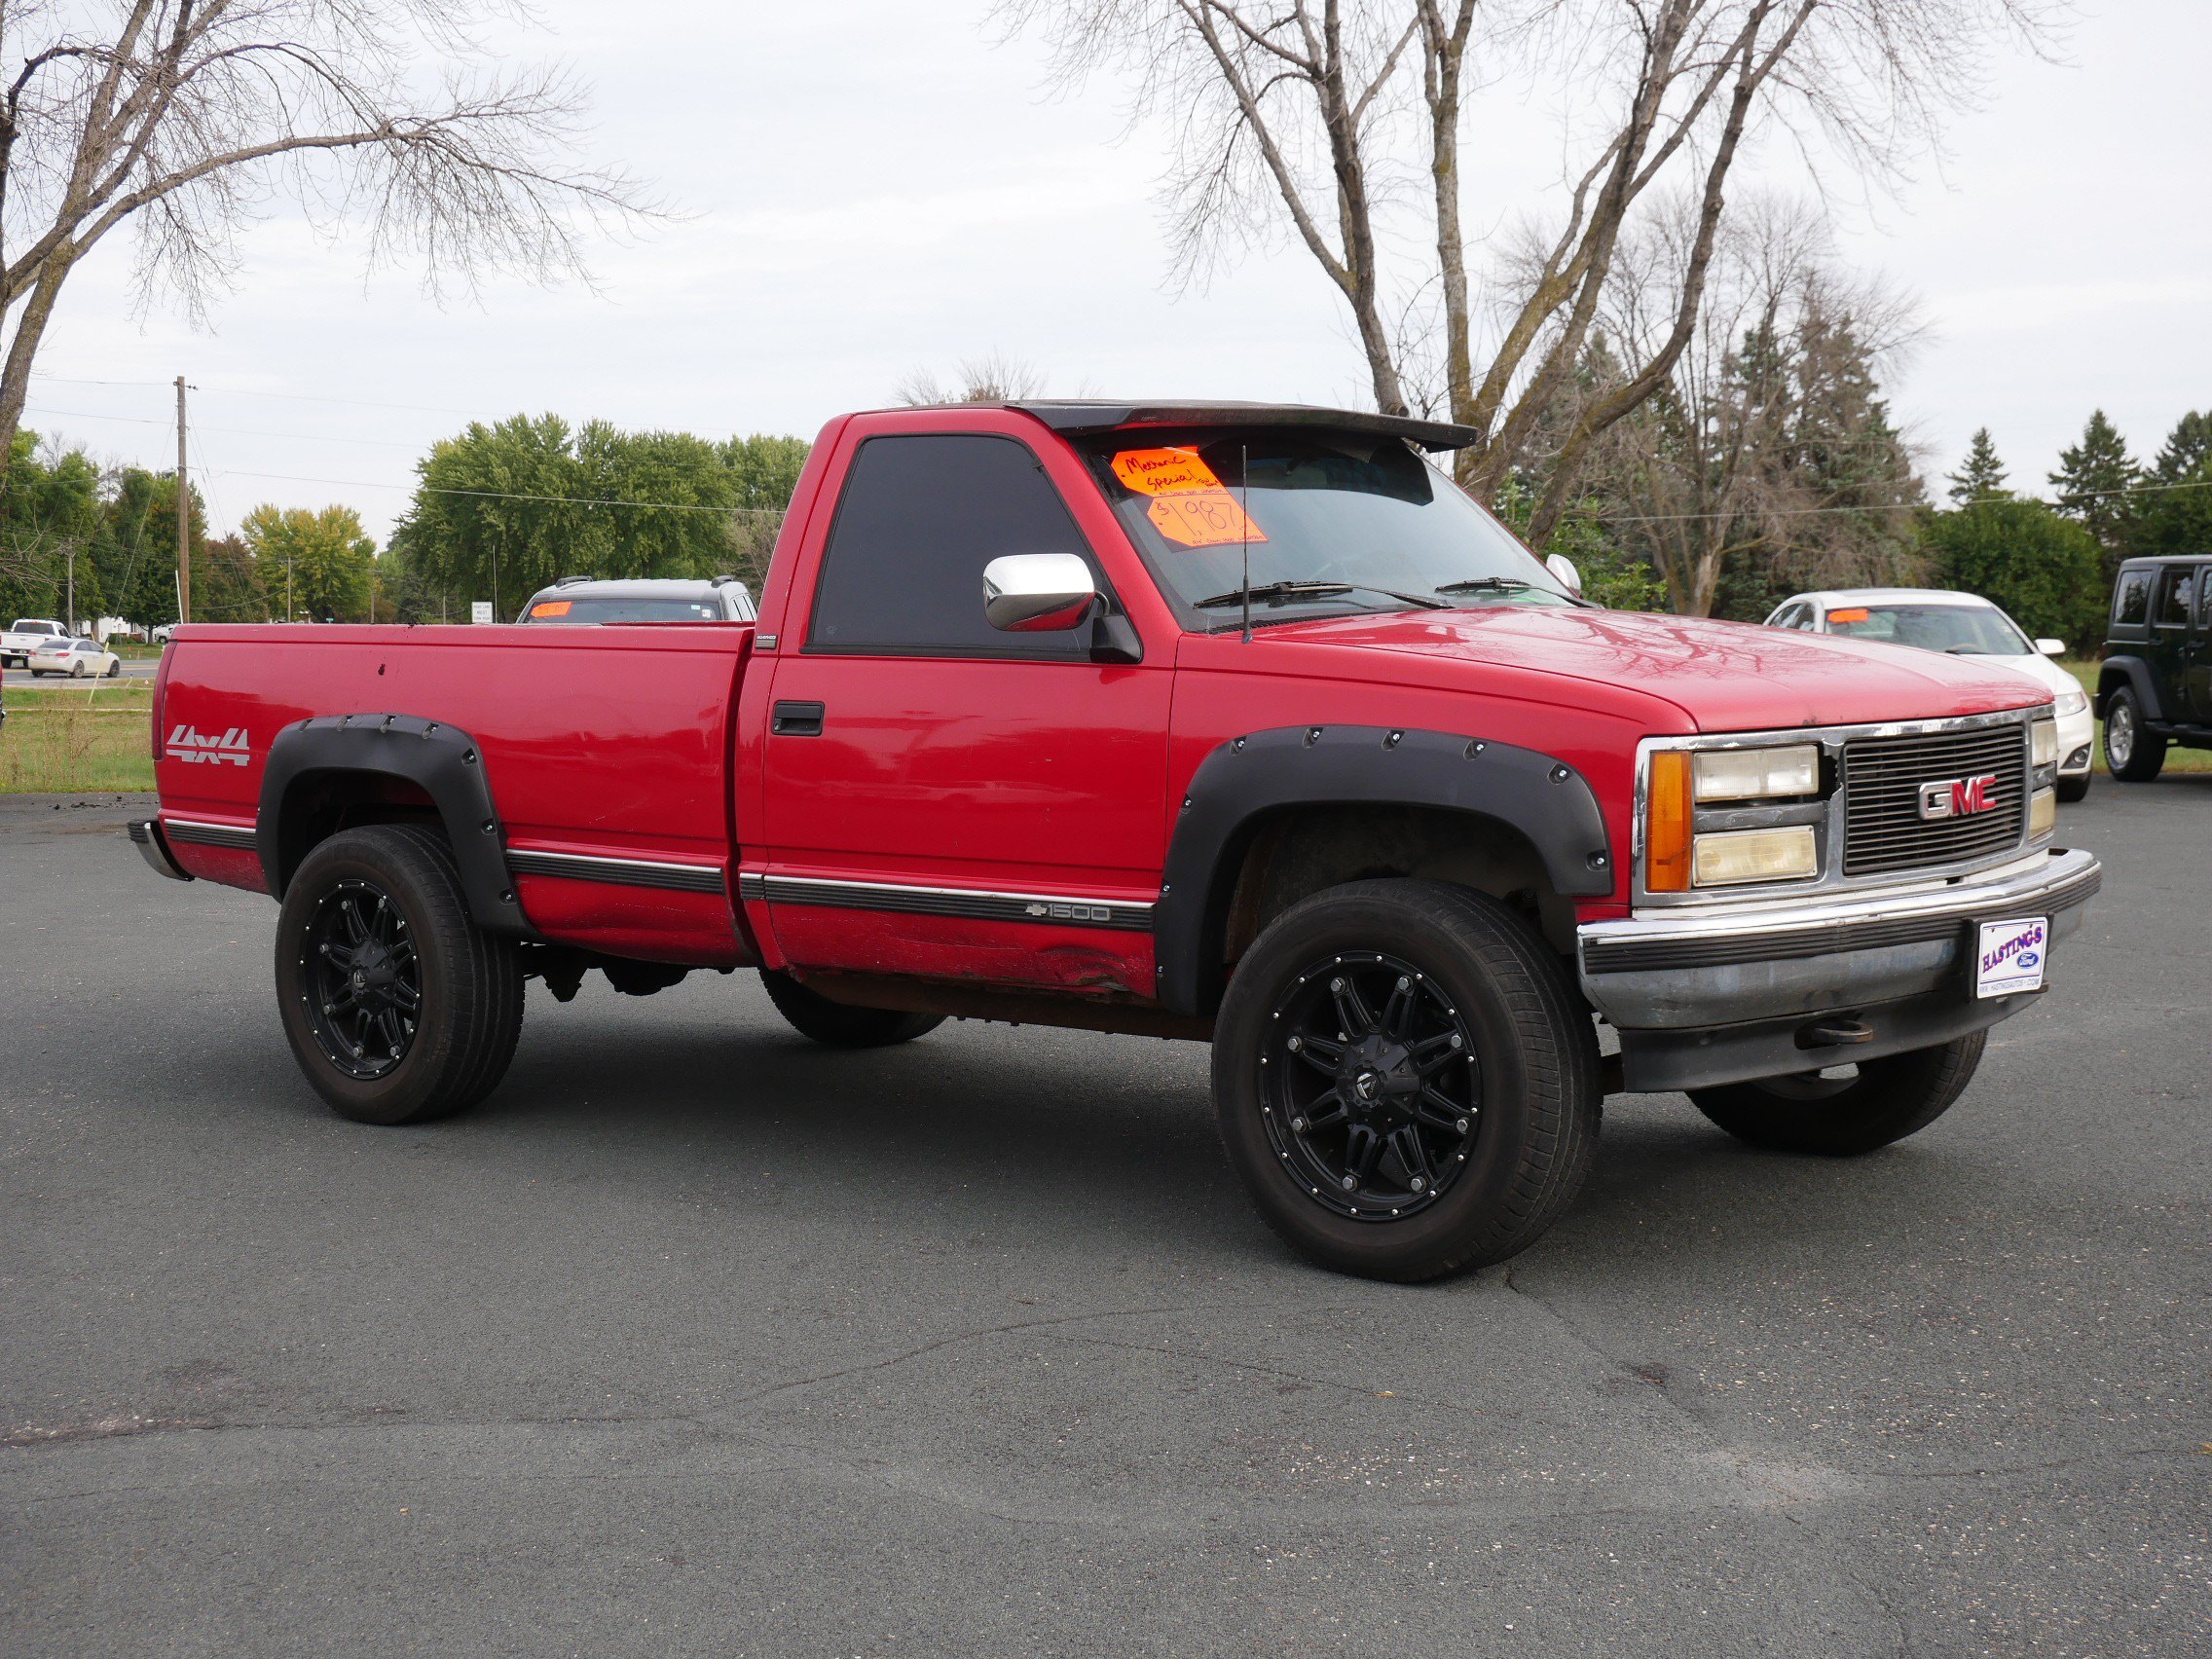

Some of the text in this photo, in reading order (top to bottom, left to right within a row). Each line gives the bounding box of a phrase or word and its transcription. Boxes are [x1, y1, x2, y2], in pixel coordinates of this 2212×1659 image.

[1919, 774, 1997, 820] GMC
[1049, 903, 1111, 921] 1500
[1982, 926, 2043, 974] HASTINGS
